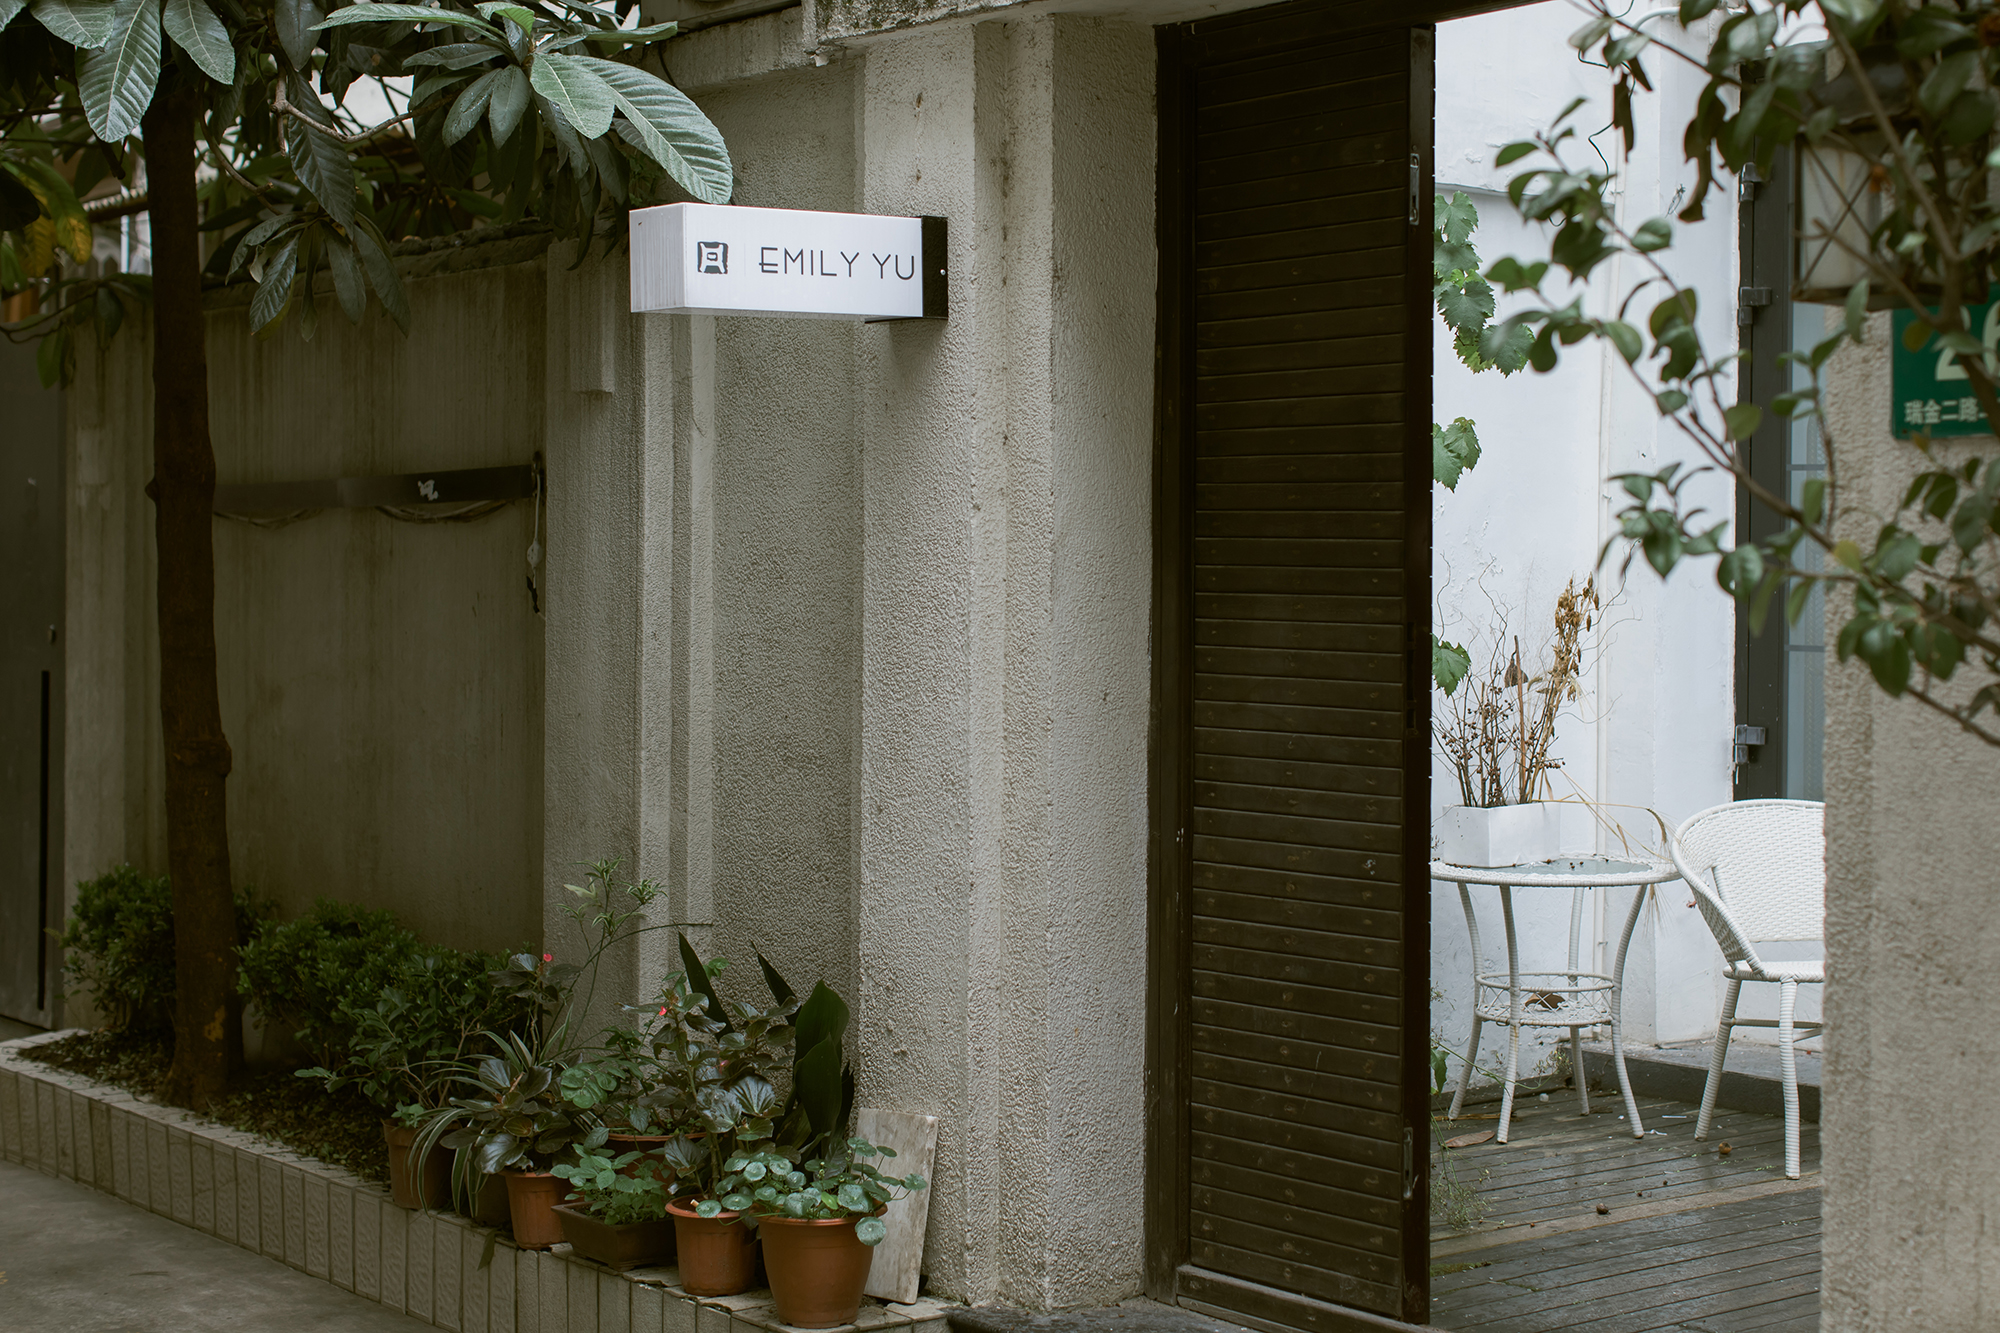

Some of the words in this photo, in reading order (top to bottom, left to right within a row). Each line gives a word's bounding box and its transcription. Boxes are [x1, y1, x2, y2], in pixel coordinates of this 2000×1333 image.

[758, 246, 860, 278] EMILY
[871, 252, 915, 280] YU
[1904, 396, 2000, 425] 瑞金二路
